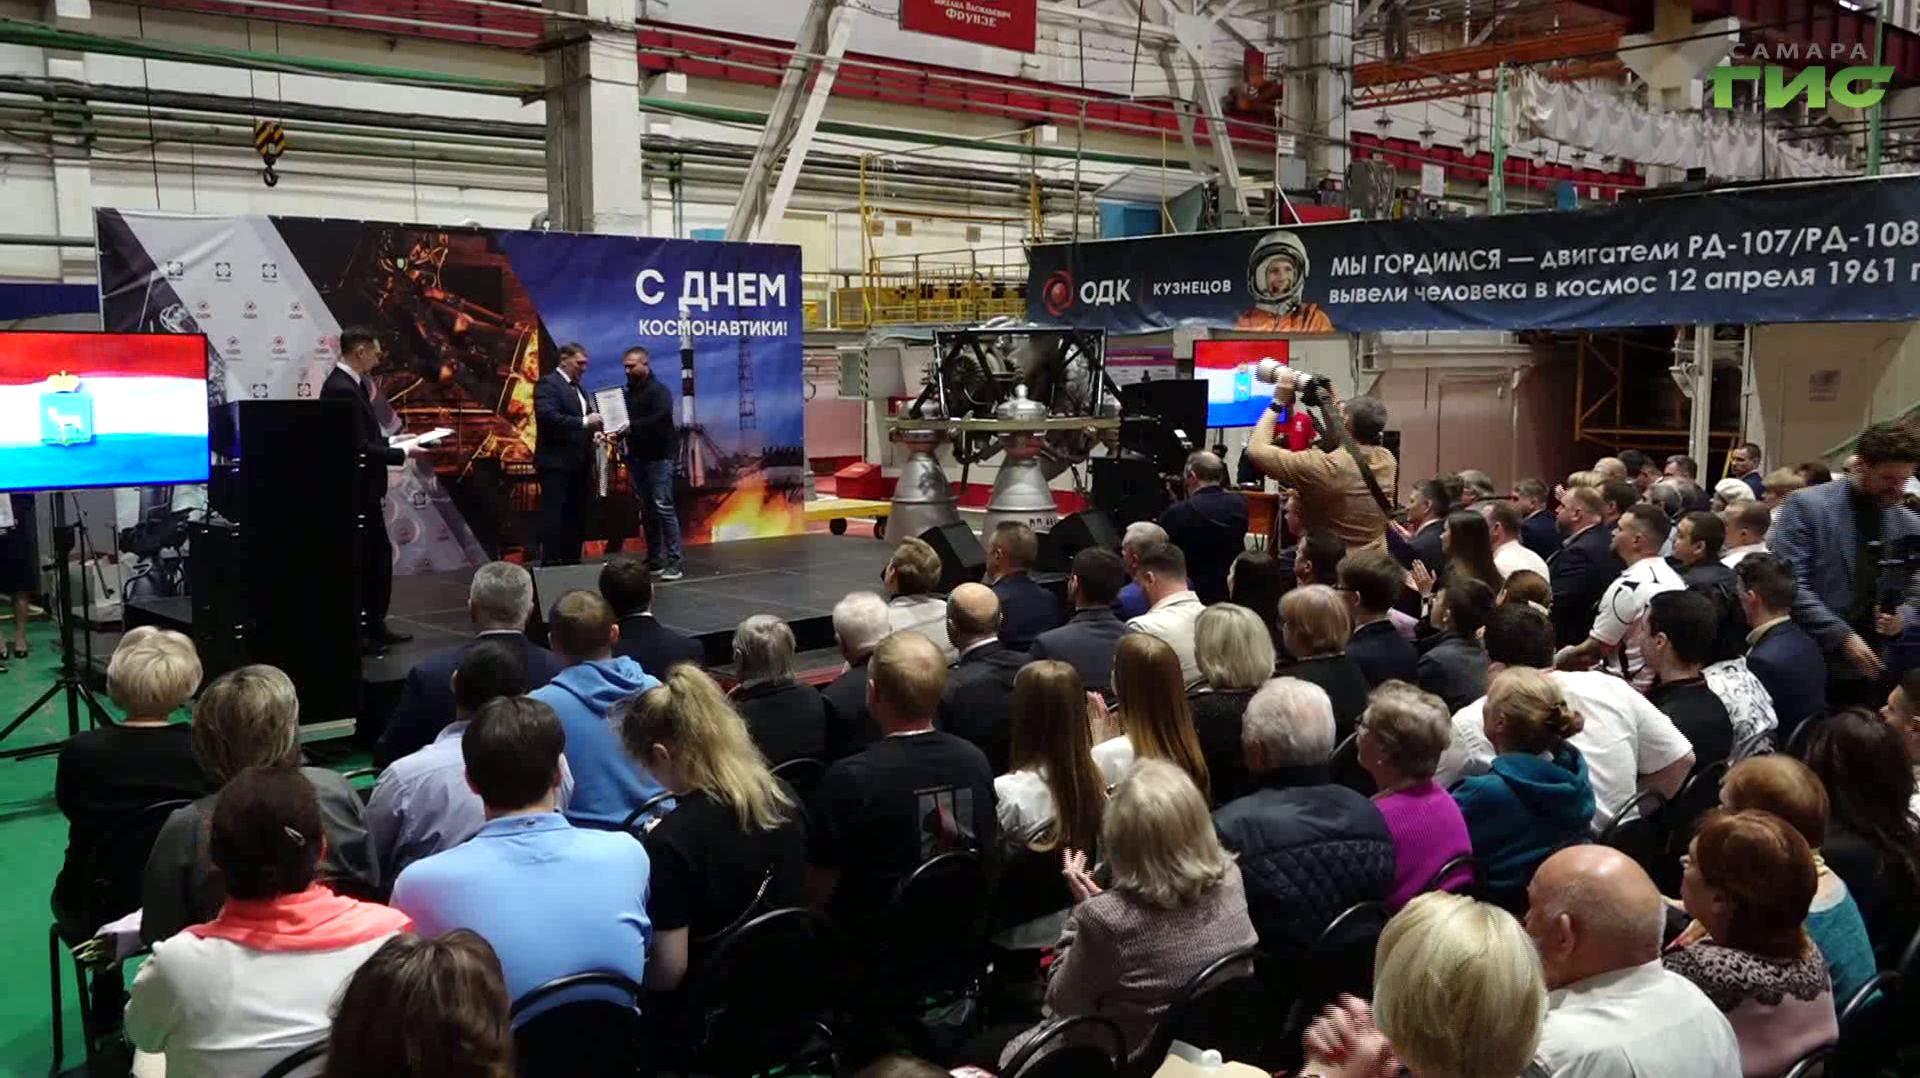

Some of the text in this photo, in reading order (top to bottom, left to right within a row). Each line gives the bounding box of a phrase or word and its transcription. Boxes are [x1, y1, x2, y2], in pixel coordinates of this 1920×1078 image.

[945, 7, 998, 28] ФРУНЗЕ
[1330, 255, 1367, 277] МЫ
[1373, 248, 1501, 275] ГОРДИМСЯ
[1688, 220, 1919, 260] РД-107/РД-108
[635, 269, 786, 312] С ДНЕМ
[1080, 279, 1131, 306] ОДК
[1153, 279, 1232, 296] КУЗНЕЦОВ
[1329, 286, 1408, 304] вывели
[1415, 281, 1527, 301] человека
[1556, 275, 1657, 297] космос
[1668, 268, 1697, 292] 12
[1704, 267, 1816, 294] апреля
[1828, 257, 1896, 285] 1961
[639, 319, 788, 337] КОСМОНАВТИКИ!
